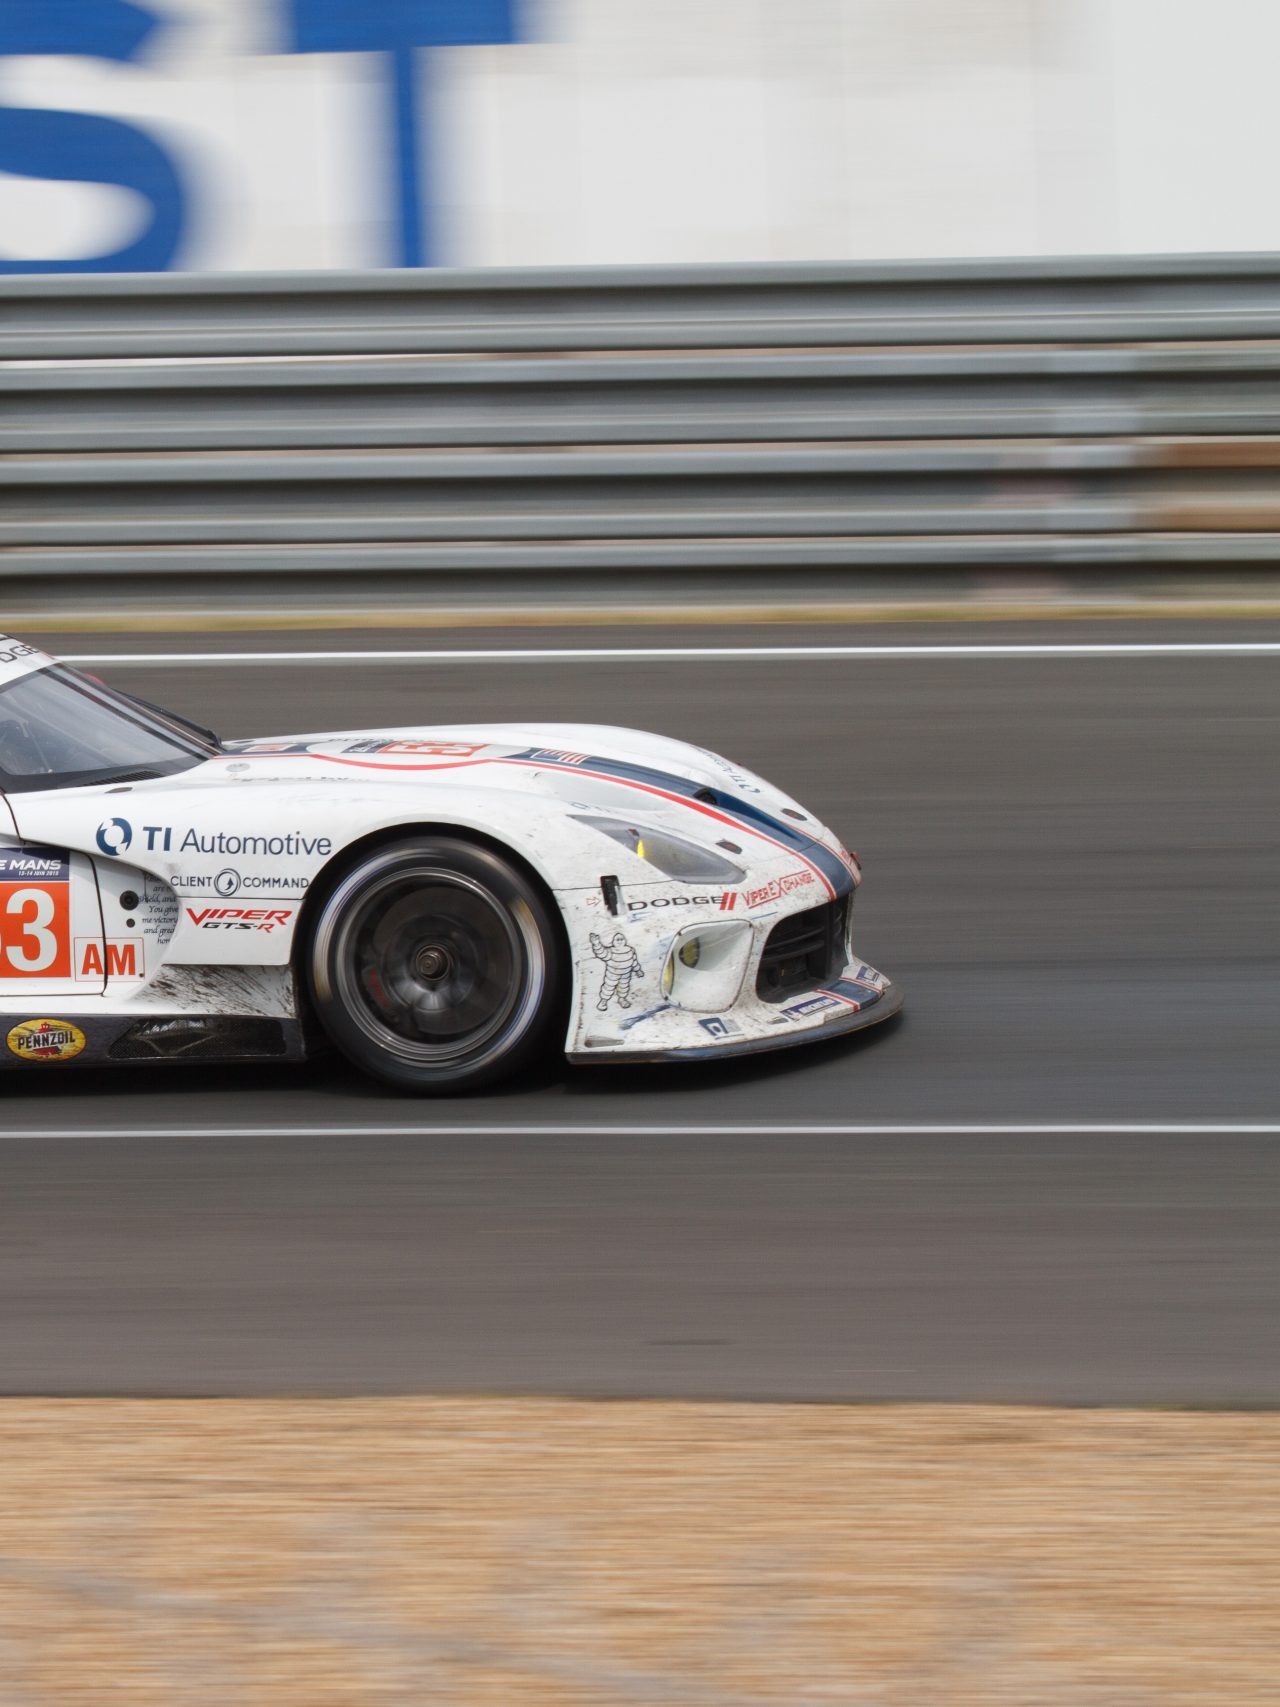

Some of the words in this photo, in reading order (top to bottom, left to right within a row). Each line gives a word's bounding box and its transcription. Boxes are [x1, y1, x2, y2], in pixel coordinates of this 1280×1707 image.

[142, 826, 172, 851] TI
[179, 827, 333, 856] Automotive
[9, 859, 62, 870] MANS
[170, 875, 213, 888] CLIENT
[242, 876, 310, 889] COMMAND
[627, 895, 727, 912] DODGE
[185, 908, 293, 926] VIPER
[202, 921, 275, 934] GTS-R
[81, 943, 136, 976] AM
[17, 1030, 76, 1050] PENNZOIL
